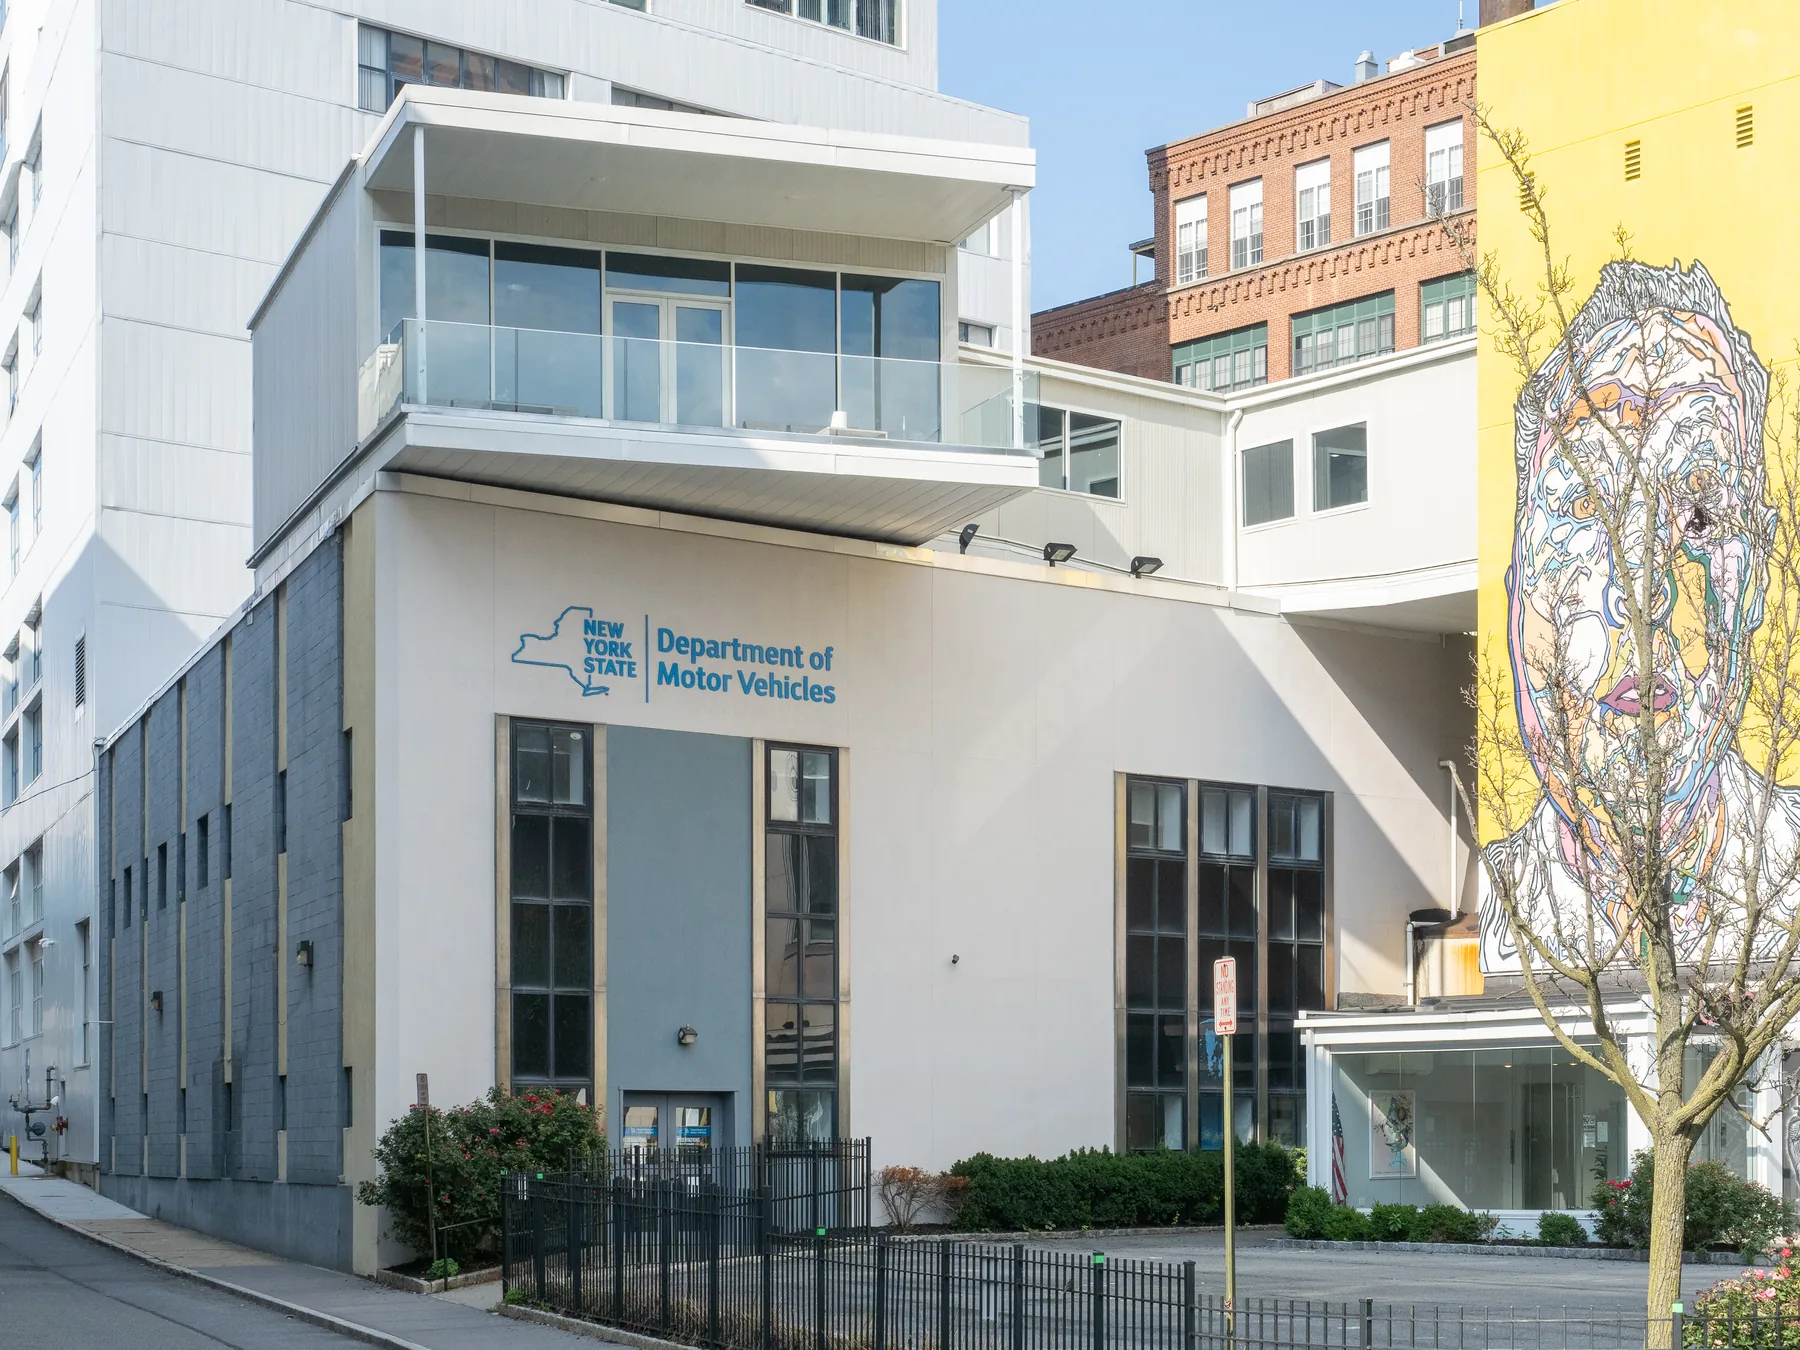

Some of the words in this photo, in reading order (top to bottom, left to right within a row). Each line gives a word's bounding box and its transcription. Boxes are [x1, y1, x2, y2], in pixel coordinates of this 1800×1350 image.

[584, 619, 625, 639] NEW
[584, 637, 633, 659] YORK
[657, 627, 804, 669] Department
[809, 646, 834, 671] of
[584, 656, 637, 678] STATE
[657, 661, 732, 692] Motor
[737, 669, 836, 704] Vehicles
[1221, 964, 1229, 978] NO
[1216, 980, 1234, 995] STANDING
[1221, 997, 1230, 1006] ANY
[1220, 1007, 1230, 1017] TIME
